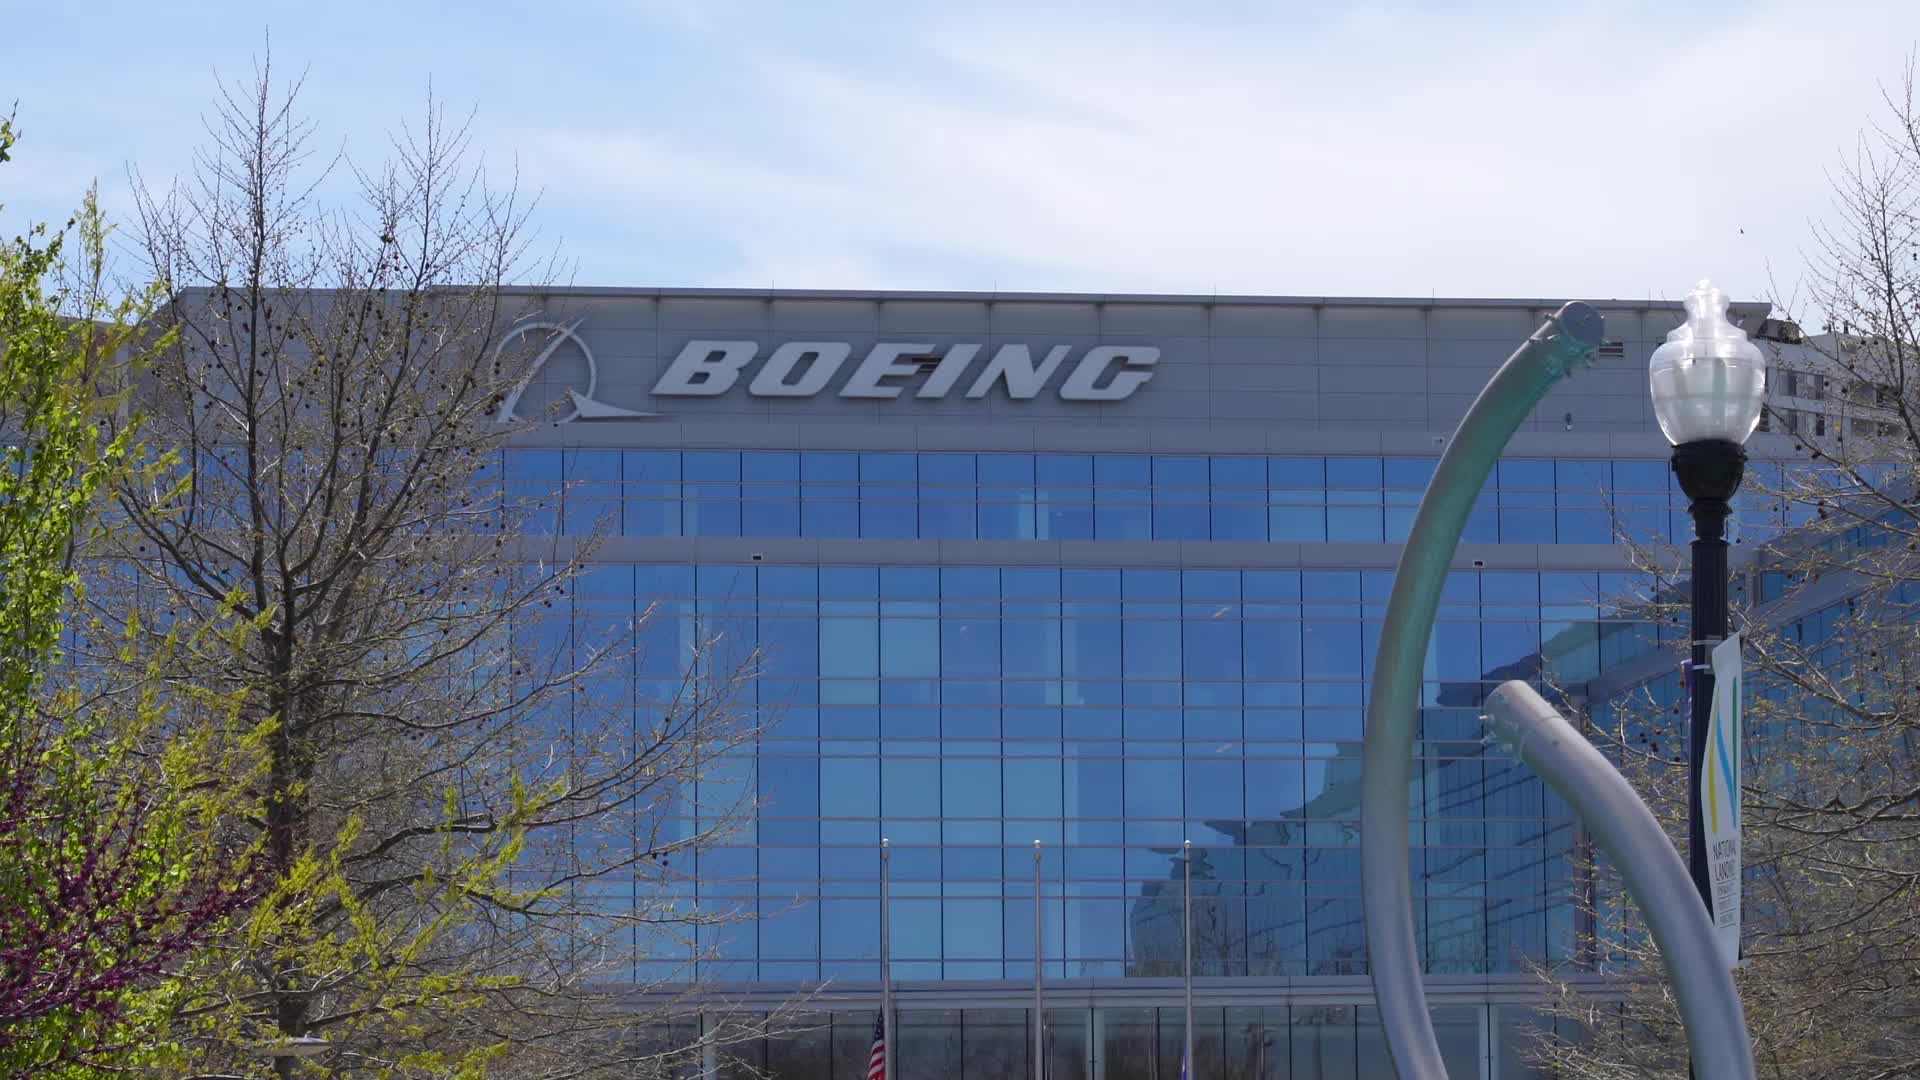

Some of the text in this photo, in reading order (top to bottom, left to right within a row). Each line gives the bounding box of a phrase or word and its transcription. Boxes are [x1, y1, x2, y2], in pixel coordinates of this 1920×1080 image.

[649, 339, 1161, 400] BOEING
[1712, 839, 1737, 860] NATION
[1714, 860, 1736, 881] LAND
